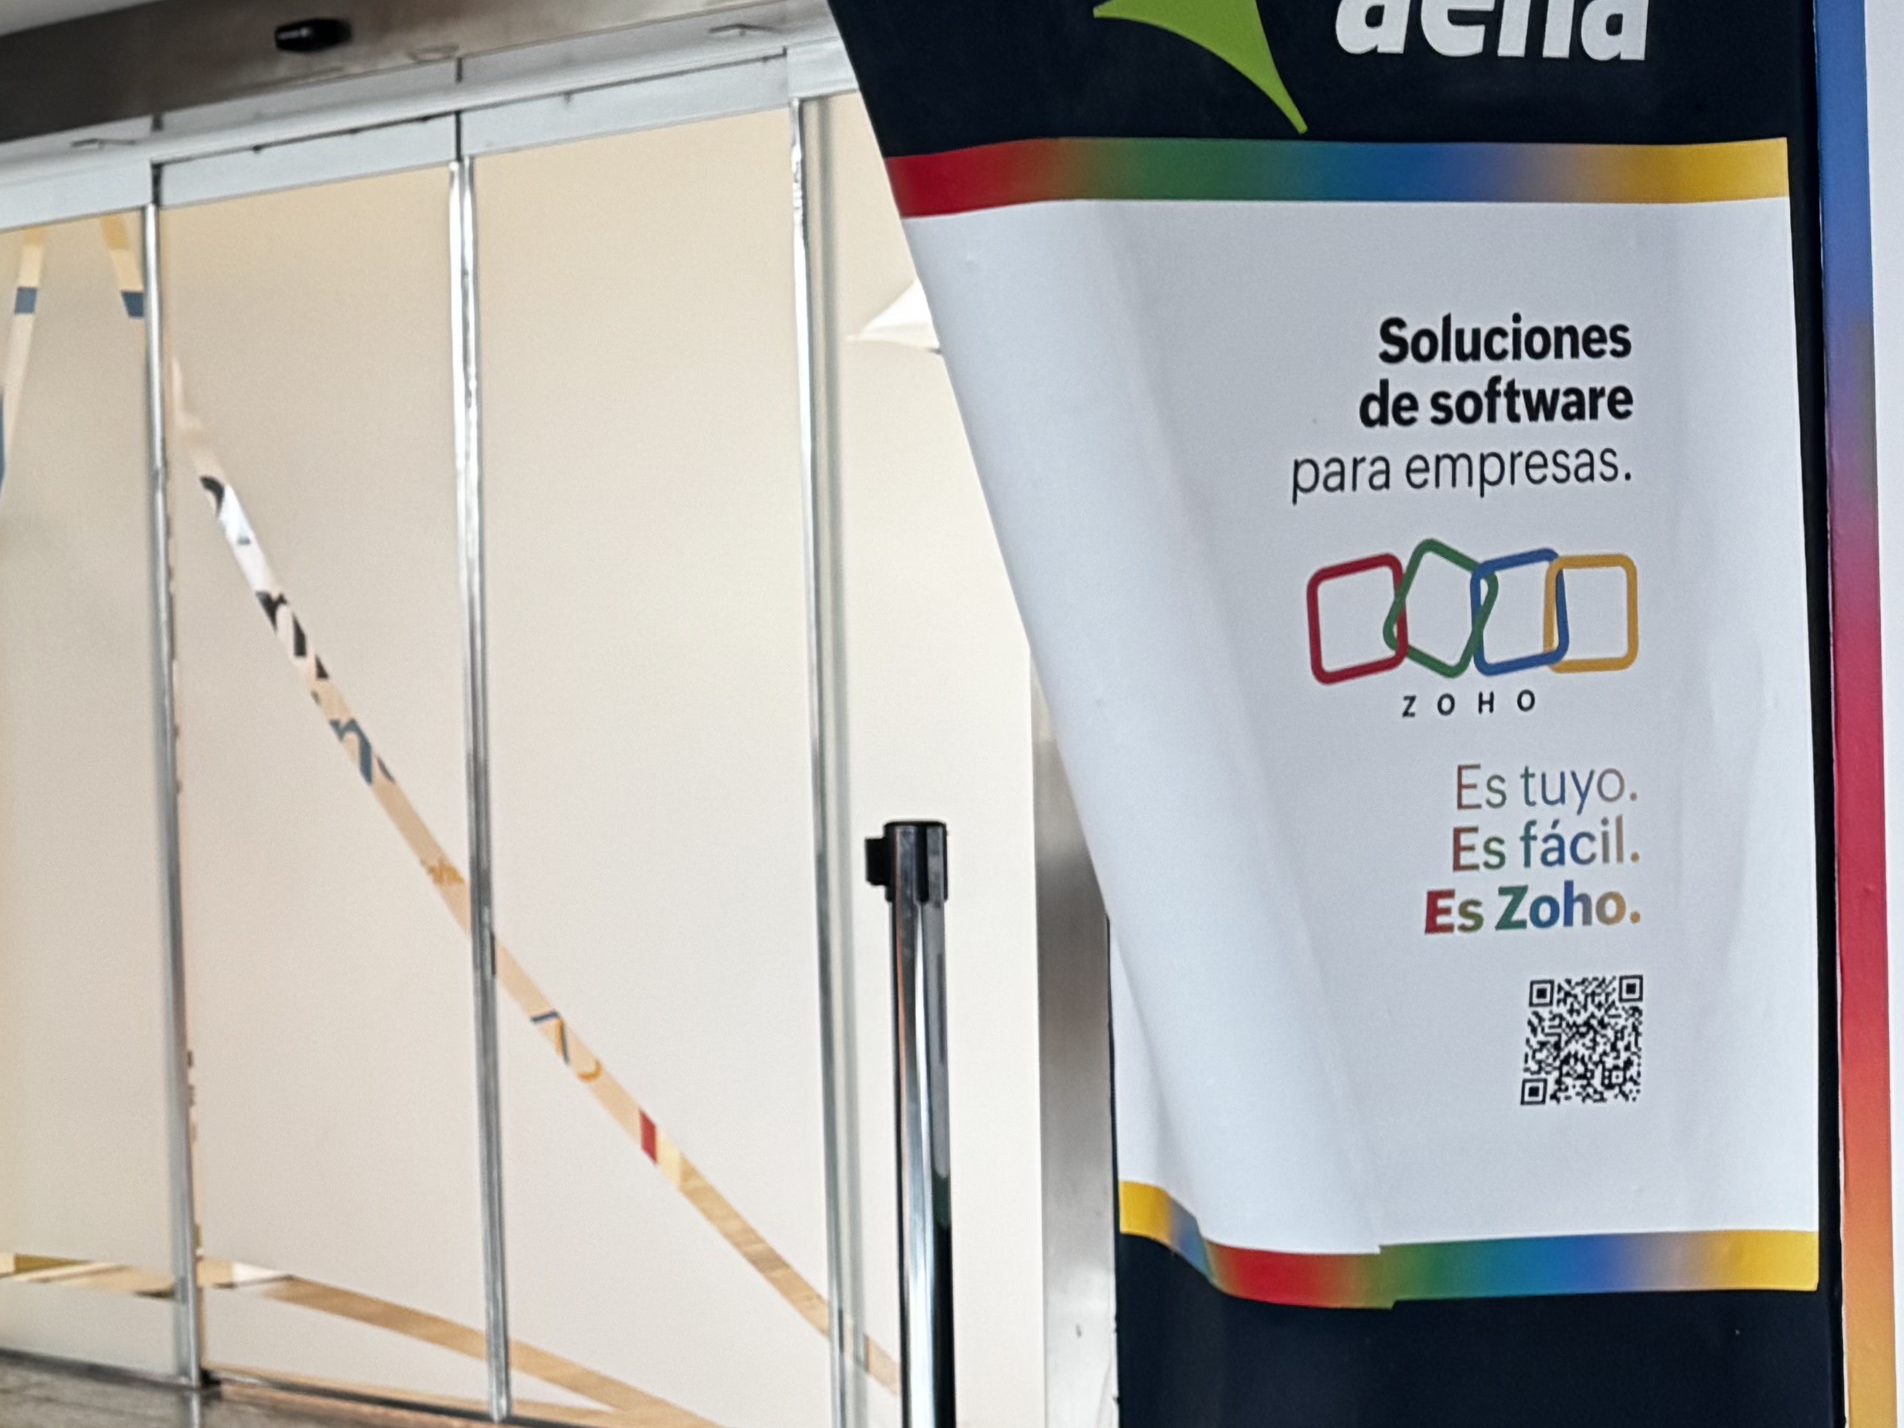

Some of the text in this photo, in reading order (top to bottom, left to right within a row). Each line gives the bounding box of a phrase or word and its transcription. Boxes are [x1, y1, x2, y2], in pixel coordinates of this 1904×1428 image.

[1378, 312, 1632, 365] Soluciones
[1359, 374, 1634, 428] de software
[1291, 447, 1632, 506] para empresas.
[1402, 689, 1536, 718] ZOHO
[1456, 763, 1638, 816] Es tuyo.
[1452, 815, 1640, 872] Es fácil.
[1424, 879, 1641, 935] Es Zoho.
